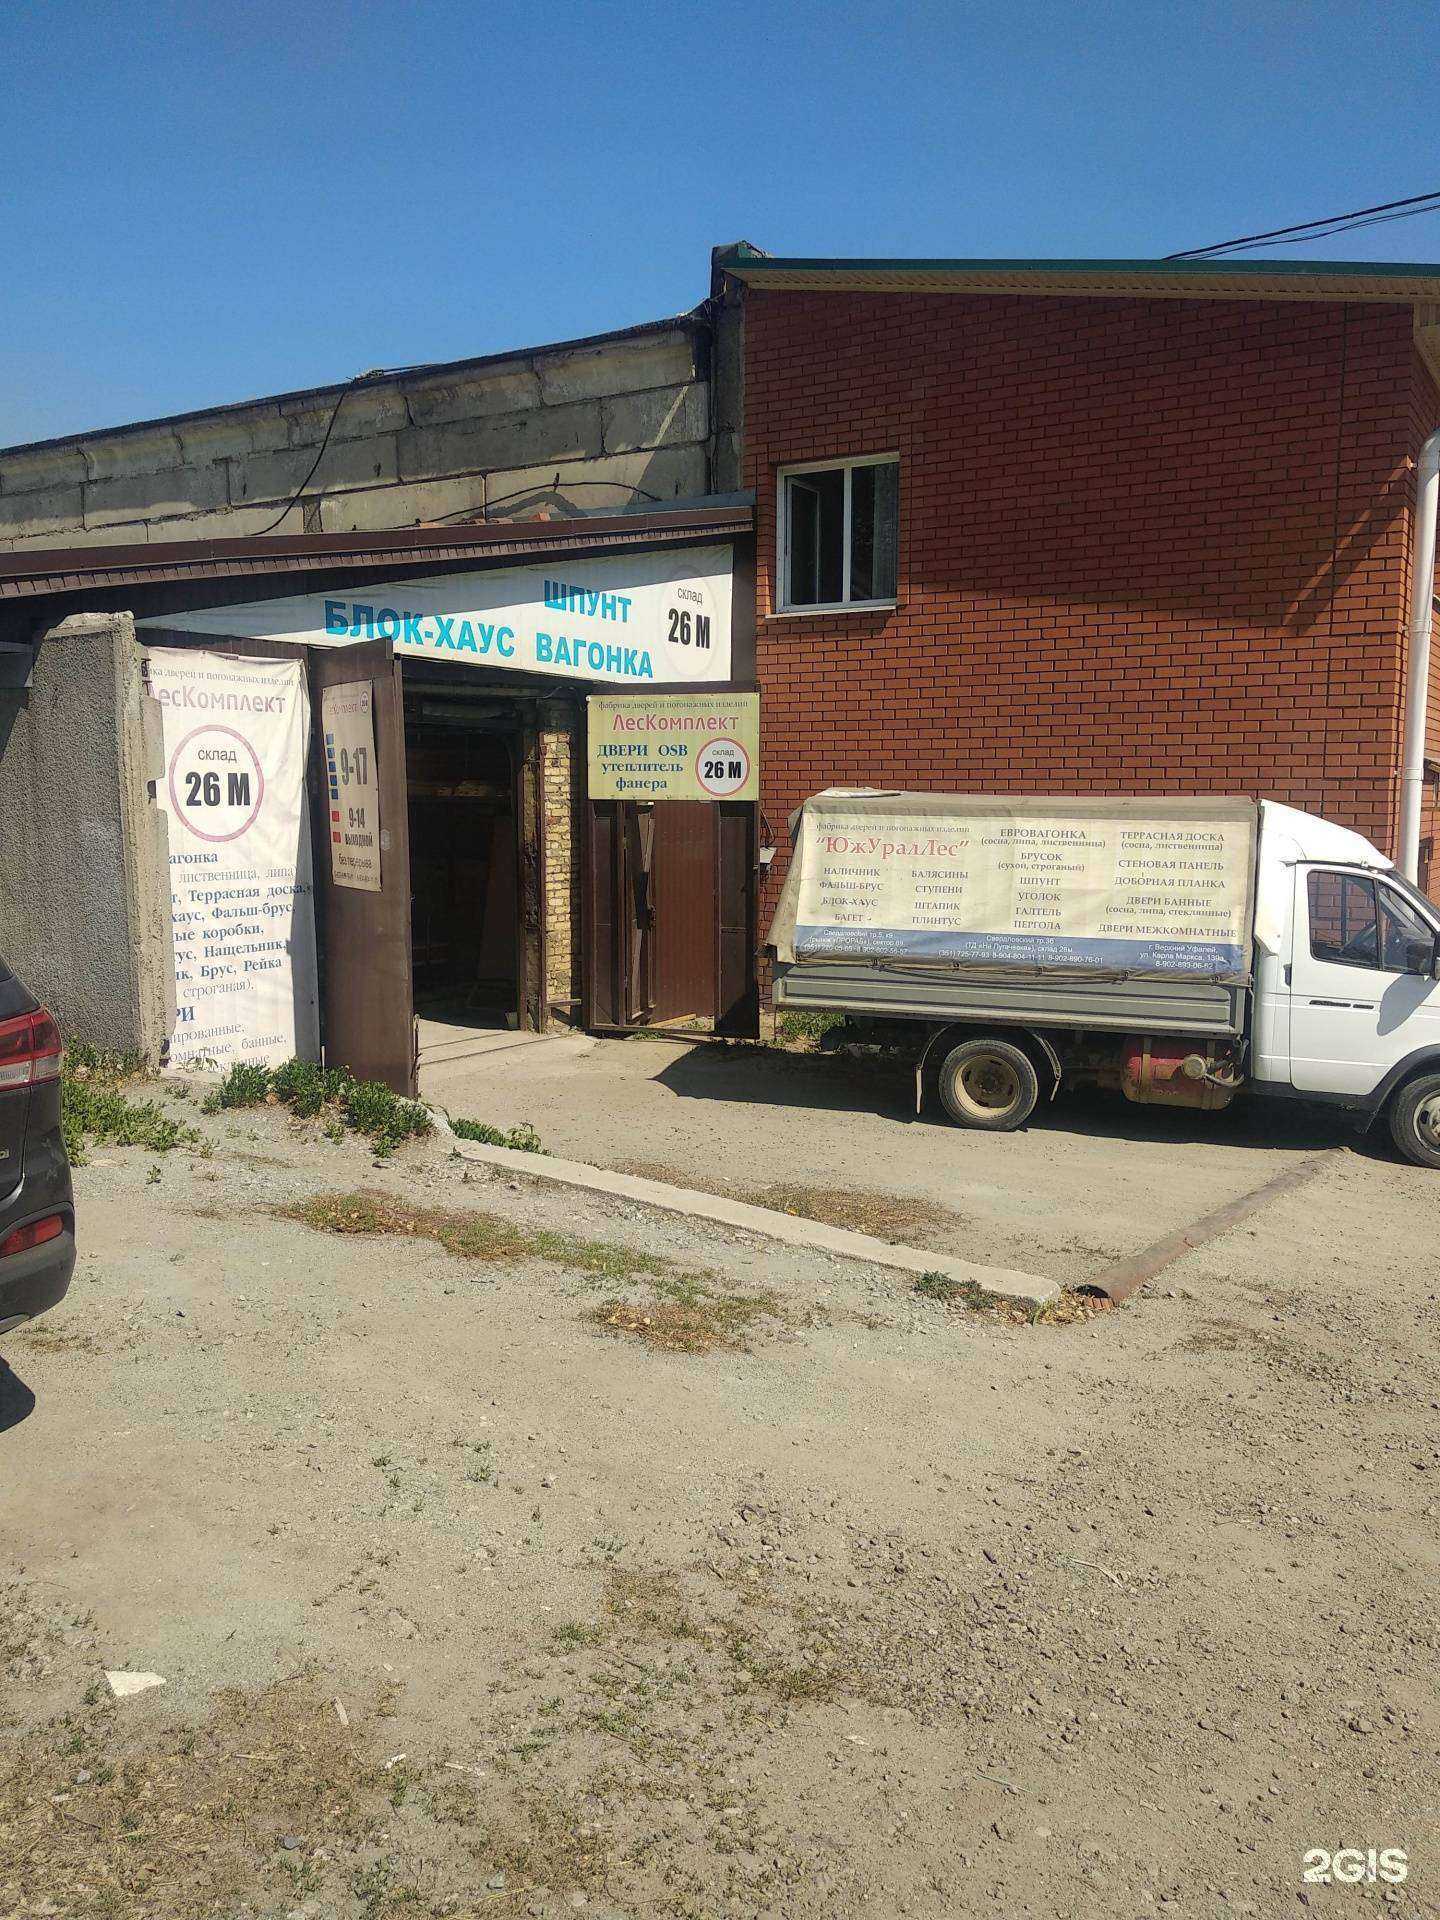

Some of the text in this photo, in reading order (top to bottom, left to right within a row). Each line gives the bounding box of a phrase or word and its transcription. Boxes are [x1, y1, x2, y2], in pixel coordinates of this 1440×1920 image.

[544, 580, 632, 623] ШПУНТ
[677, 587, 703, 606] склад
[668, 608, 691, 646] 26
[325, 600, 653, 678] БЛОК-ХАУС ВАГОНКА
[598, 701, 631, 711] фабрика
[632, 701, 659, 710] дверей
[613, 714, 739, 731] ЛесКомплект
[198, 749, 237, 763] склад
[597, 744, 688, 758] ДВЕРИ OSB
[712, 749, 735, 758] склад
[340, 747, 368, 785] 9-17
[601, 761, 684, 775] утеплитель
[704, 761, 724, 779] 26
[186, 772, 221, 807] 26
[615, 777, 668, 792] фанера
[349, 808, 366, 829] 9-14
[1000, 829, 1087, 839] ЕВРОВАГОНКА
[1120, 831, 1225, 842] ТЕРРАСНАЯ ДОСКА
[1121, 840, 1152, 850] (сосна,
[169, 853, 218, 865] агонка
[1021, 852, 1064, 861] БРУСОК
[1118, 860, 1224, 871] СТЕНОВАЯ ПАНЕЛЬ
[823, 867, 881, 877] НАЛИЧНИК
[911, 870, 969, 880] БАЛЯСИНЫ
[819, 881, 885, 892] ФАЛЬШ-БРУС
[1020, 877, 1061, 886] ШПУНТ
[1114, 877, 1226, 889] ДОБОРНАЯ ПЛАНКА
[915, 885, 963, 894] СТУПЕНИ
[188, 888, 260, 904] Террасная
[820, 896, 879, 907] БЛОК-ХАУС
[1018, 892, 1062, 902] УГОЛОК
[1126, 896, 1212, 907] ДВЕРИ БАННЫЕ
[914, 901, 960, 911] ШТАПИК
[834, 913, 864, 922] БАГЕТ
[1015, 908, 1062, 917] ГАЛТЕЛЬ
[912, 916, 962, 926] ПЛИНТУС
[1014, 920, 1061, 930] ПЕРГОЛА
[203, 924, 264, 940] коробки,
[1098, 924, 1237, 938] ДВЕРИ МЕЖКОМНАТНЫЕ
[204, 940, 286, 958] Нащельник,
[201, 965, 237, 979] Брус,
[244, 957, 282, 972] Рейка
[170, 1043, 235, 1062] омнатные,
